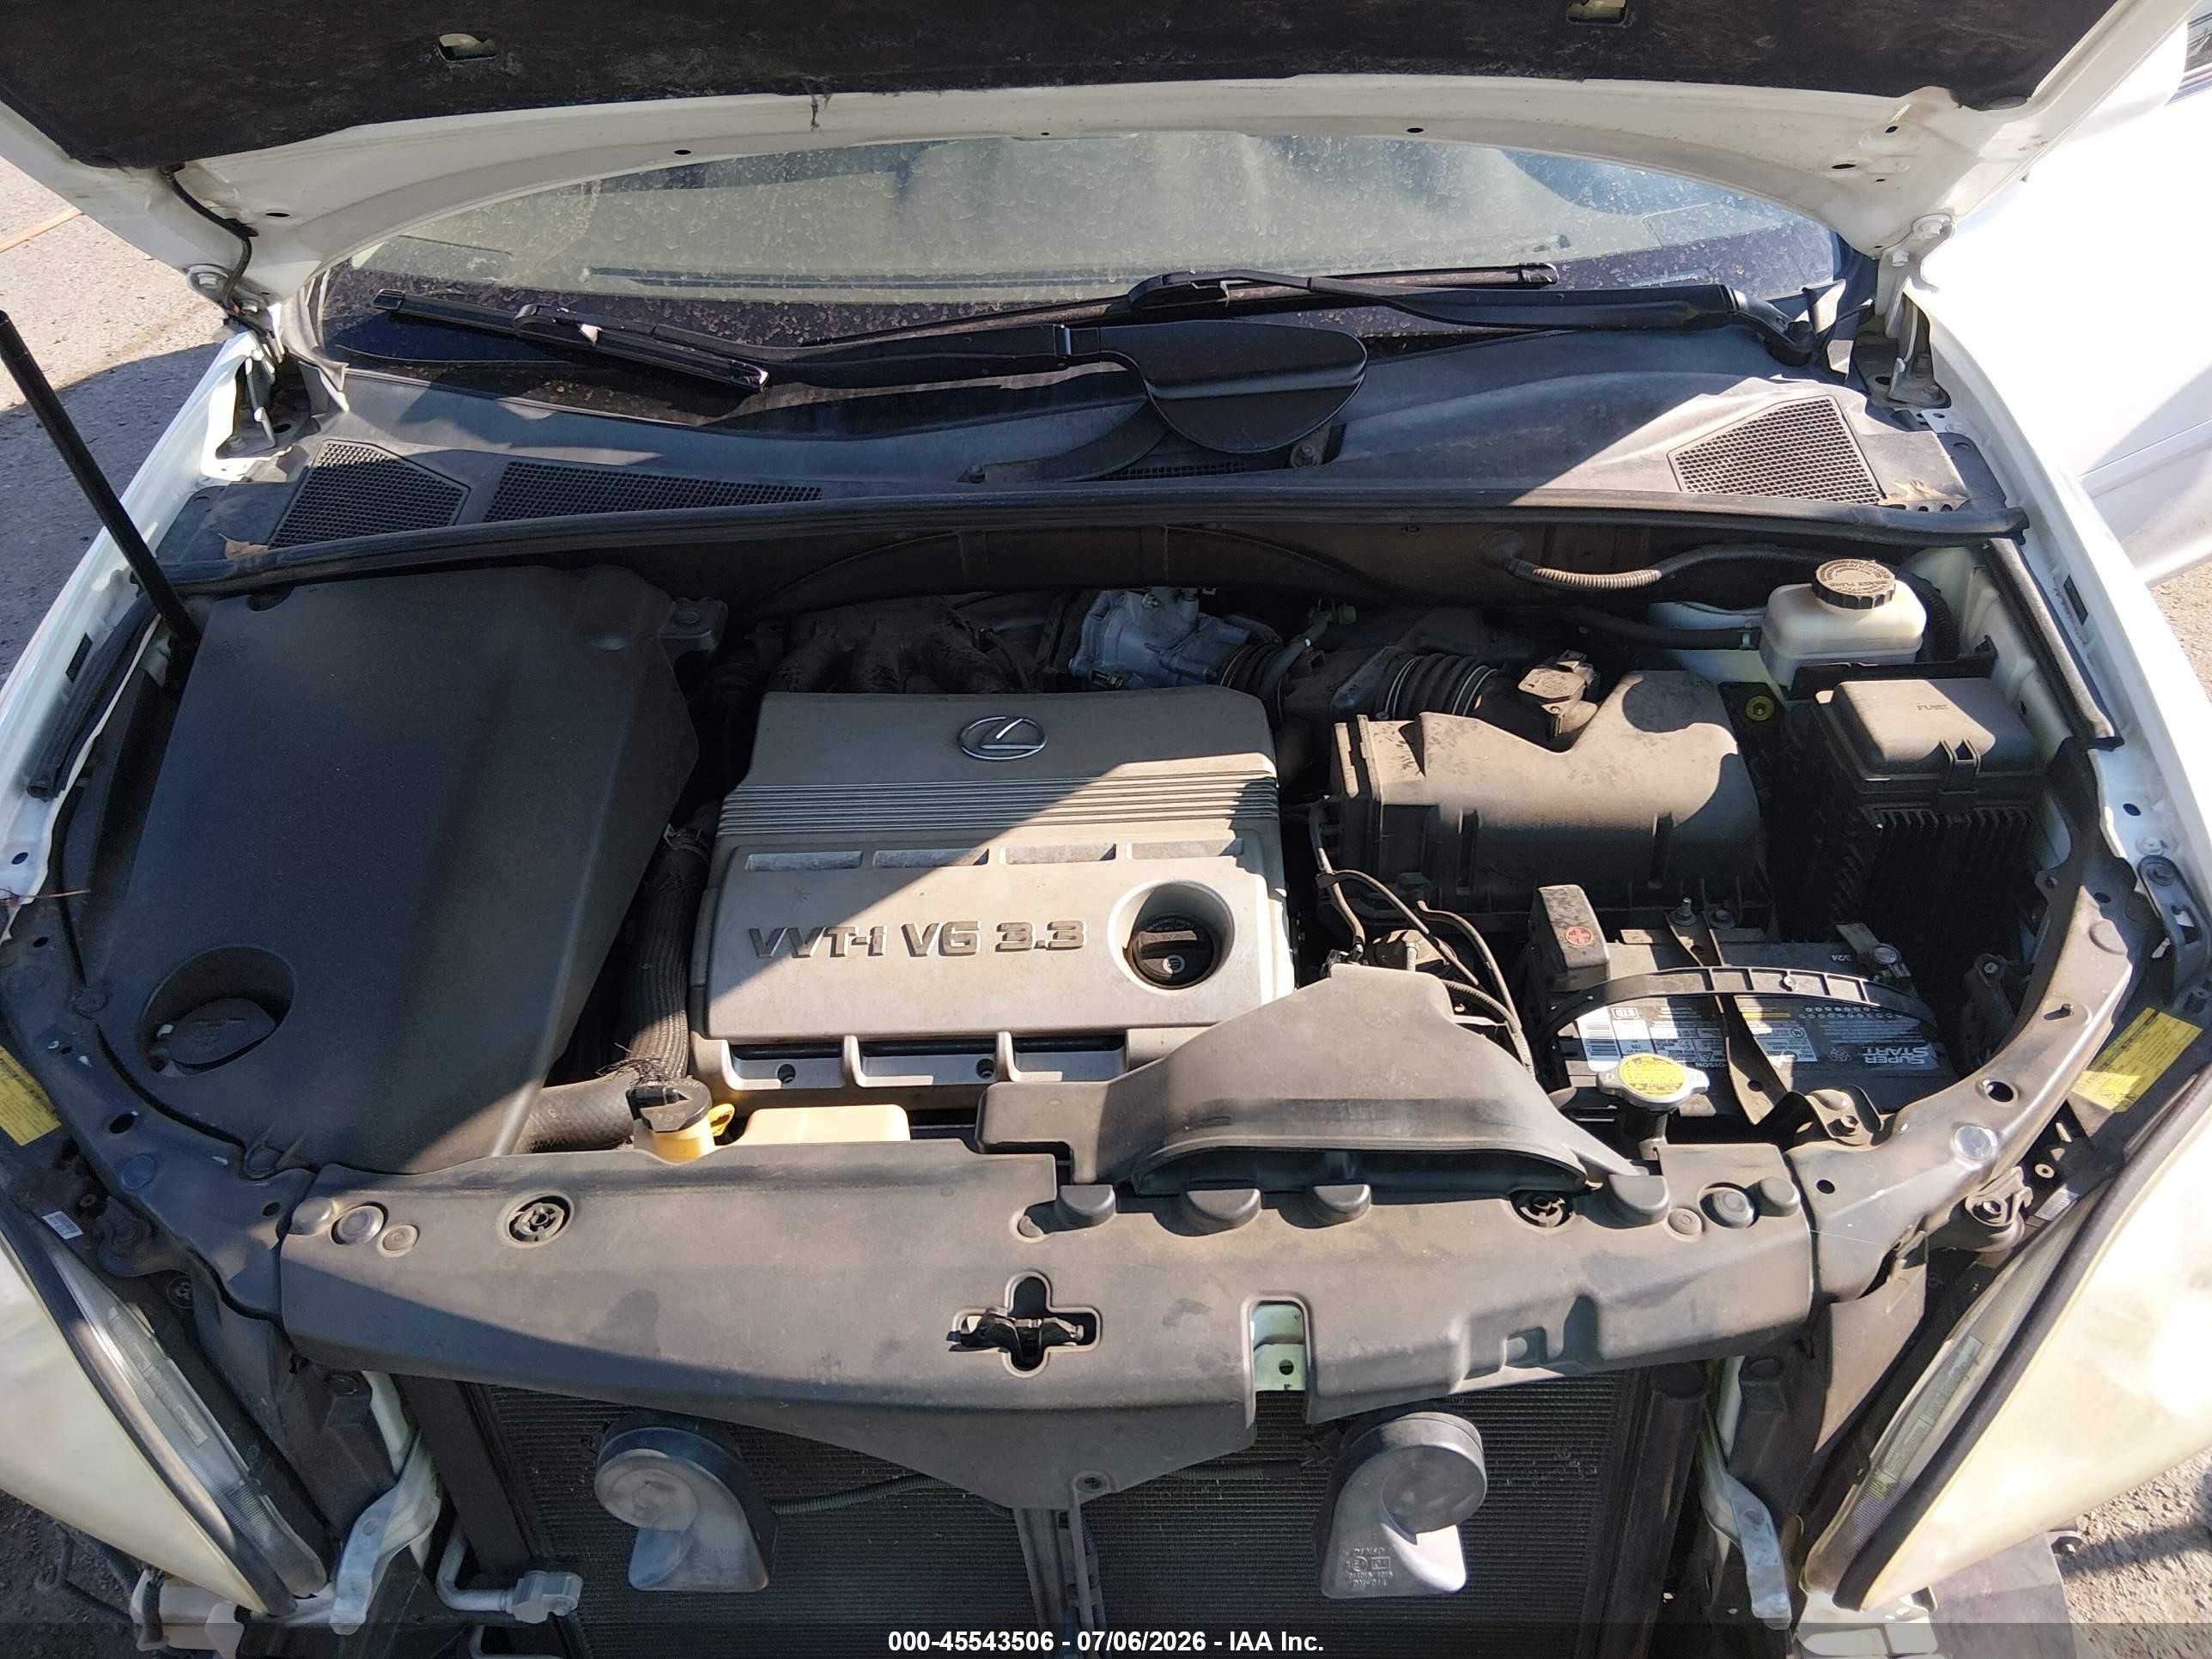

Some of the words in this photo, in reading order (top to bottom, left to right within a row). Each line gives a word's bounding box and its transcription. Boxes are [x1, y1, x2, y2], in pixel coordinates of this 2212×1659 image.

[902, 921, 981, 957] V6
[995, 920, 1085, 952] 3.3
[1862, 1047, 1929, 1057] START
[1864, 1055, 1924, 1065] SUPER
